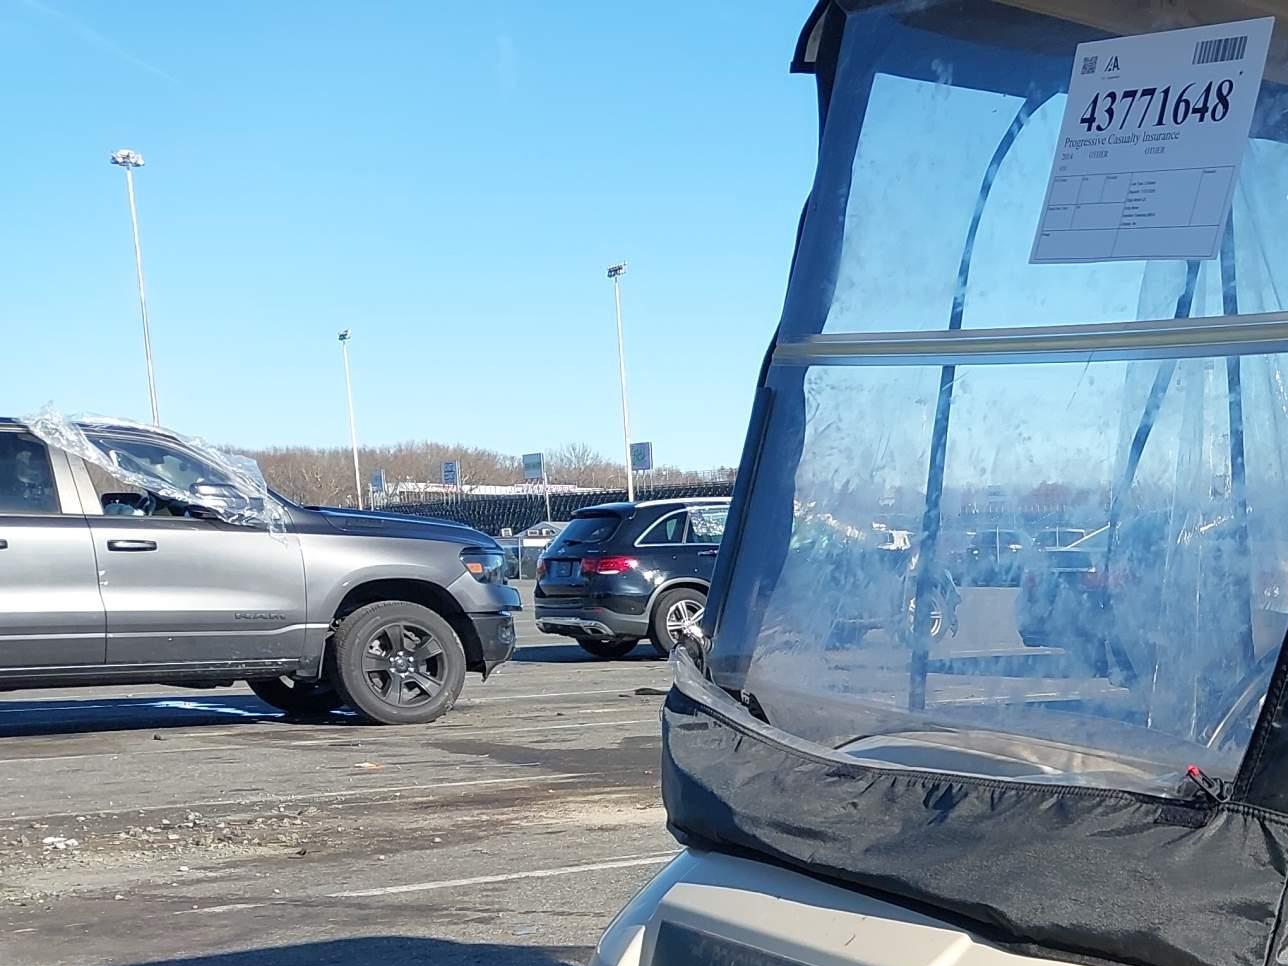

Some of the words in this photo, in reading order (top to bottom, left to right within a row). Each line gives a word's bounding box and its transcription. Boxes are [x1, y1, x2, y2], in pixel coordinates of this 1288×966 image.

[1080, 79, 1234, 132] 43771648
[1064, 137, 1106, 150] Progressive
[1108, 133, 1140, 146] Casualty
[1142, 131, 1180, 142] Insurance
[234, 611, 286, 620] RAM
